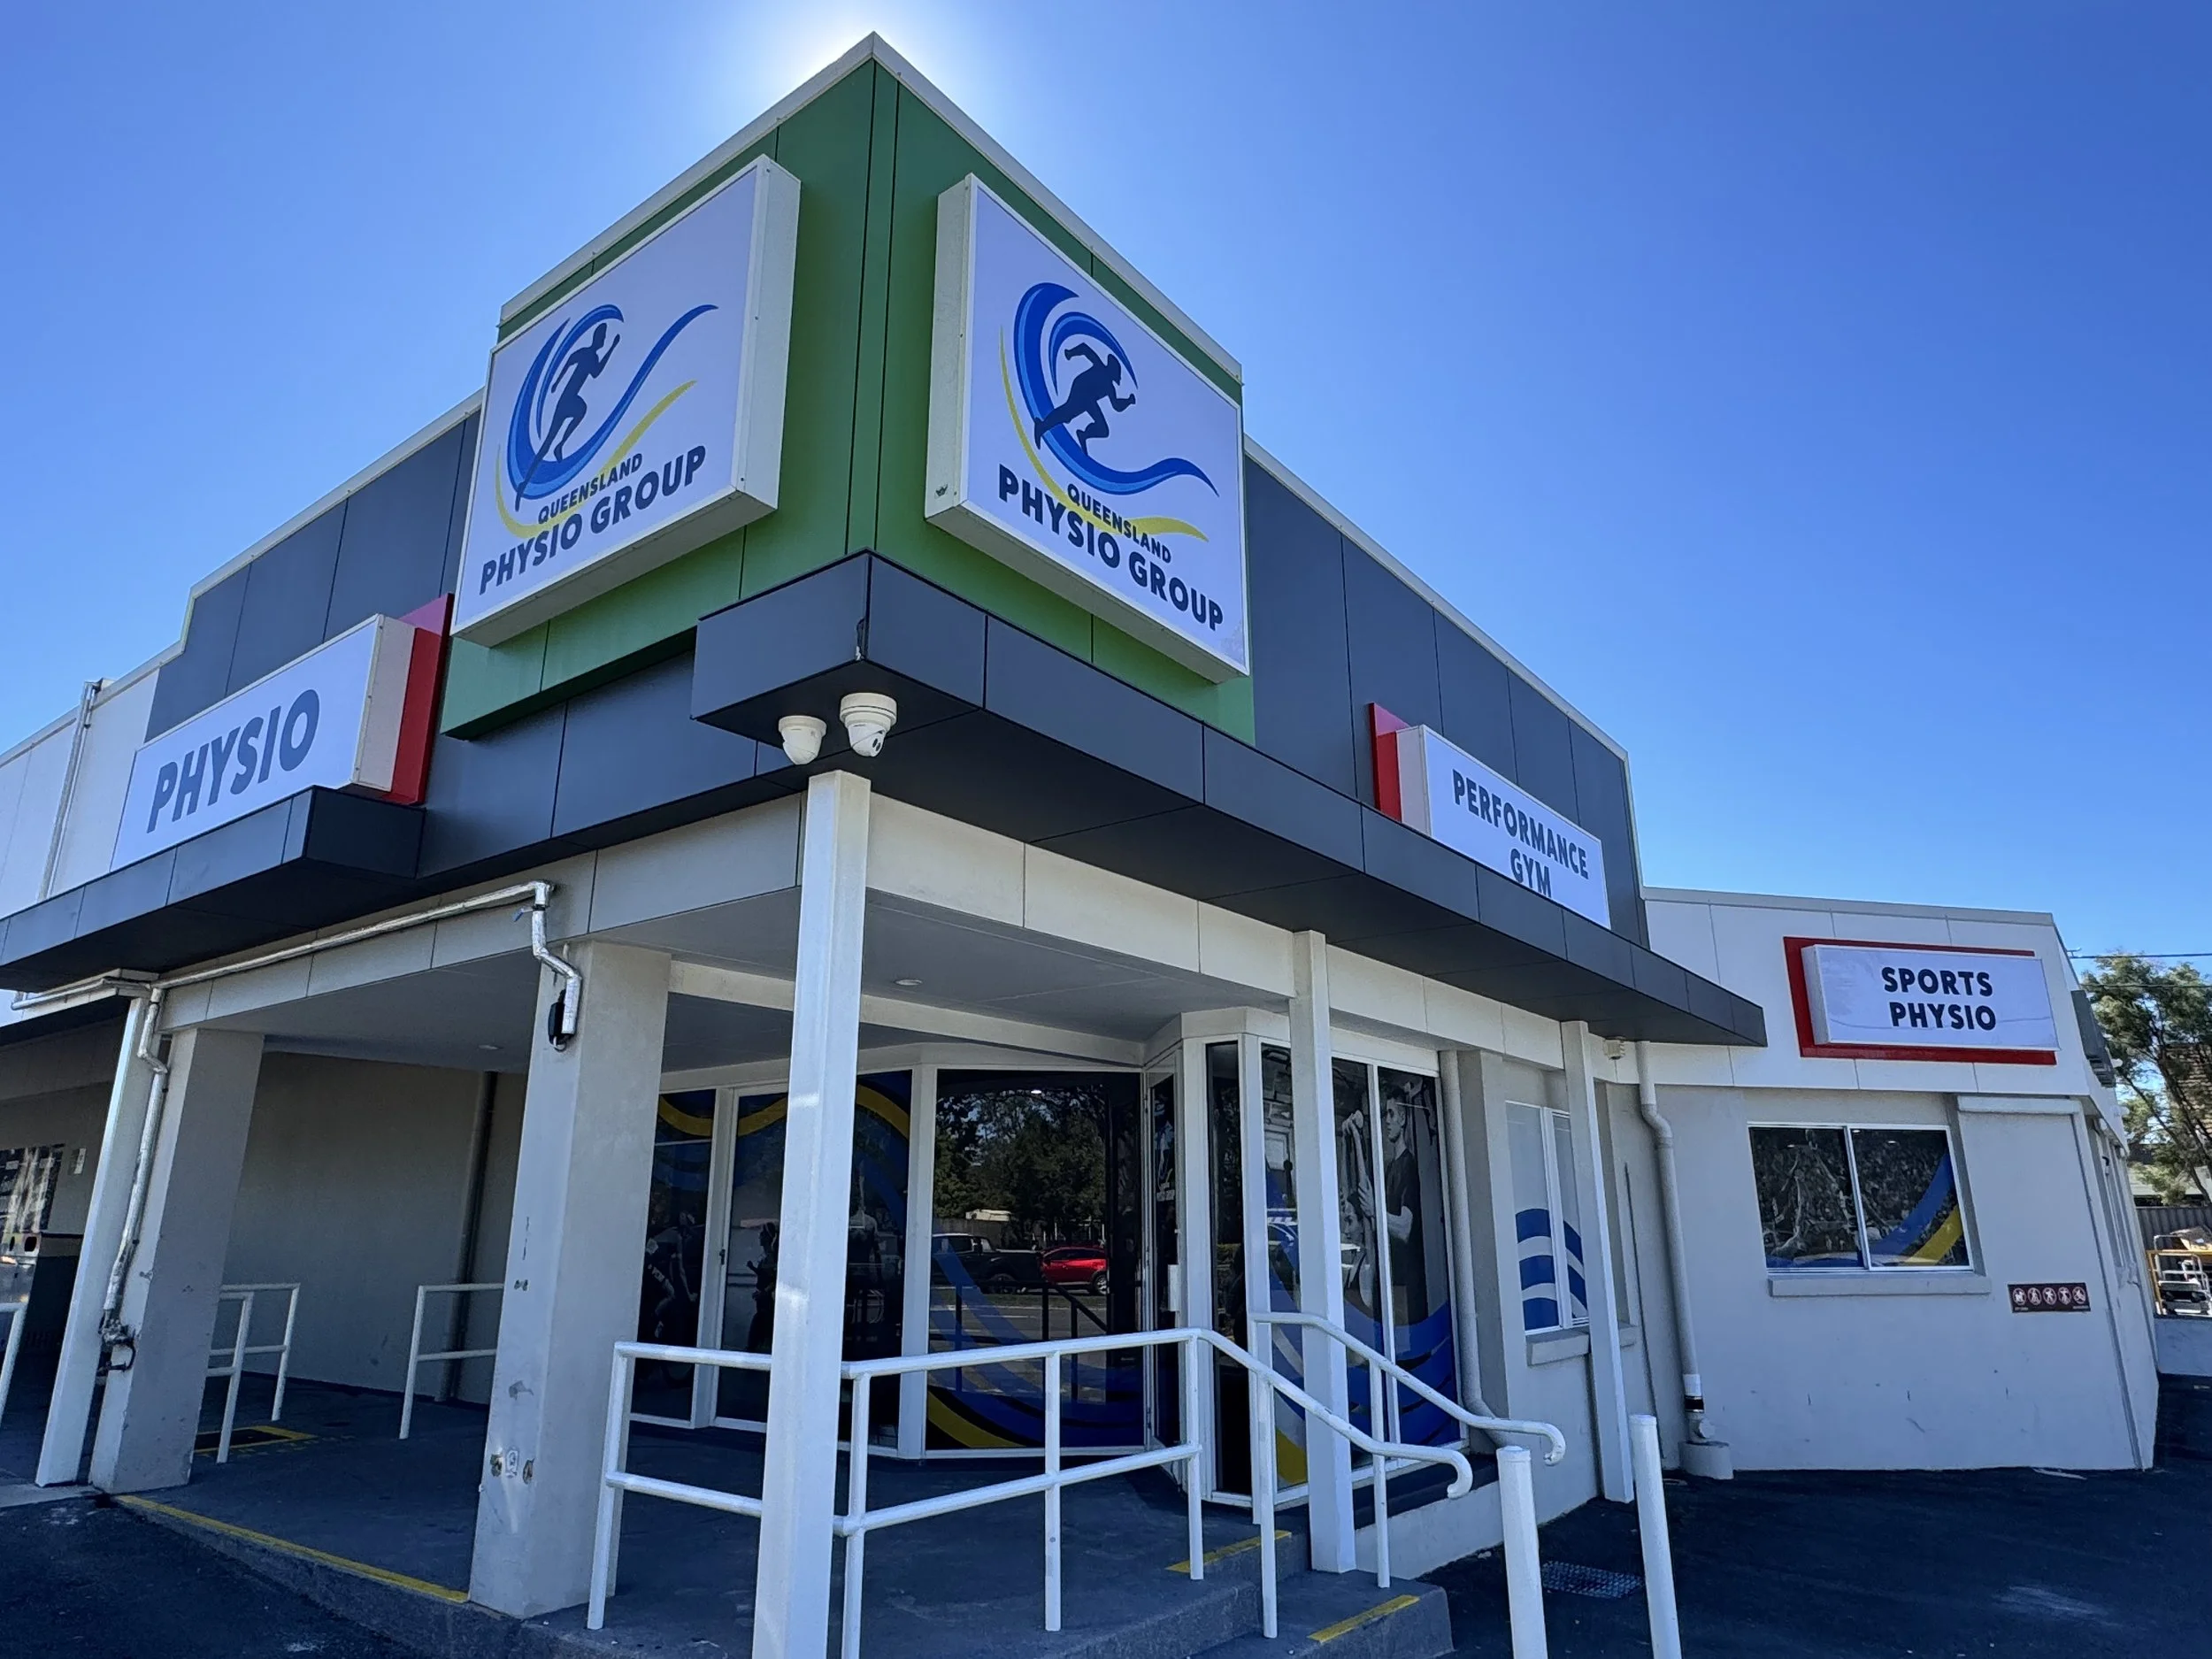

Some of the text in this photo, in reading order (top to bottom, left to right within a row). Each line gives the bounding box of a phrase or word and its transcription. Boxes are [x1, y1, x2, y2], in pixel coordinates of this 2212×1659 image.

[479, 445, 706, 595] PHYSIO GROUP
[537, 452, 643, 525] QUEENSLAND
[1067, 483, 1172, 564] QUEENSLAND
[998, 463, 1224, 632] PHYSIO GROUP
[146, 688, 320, 834] PHYSIO
[1452, 768, 1589, 880] PERFORMANCE
[1510, 848, 1553, 899] GYM
[1881, 966, 1993, 997] SPORTS
[1888, 1002, 1997, 1032] PHYSIO
